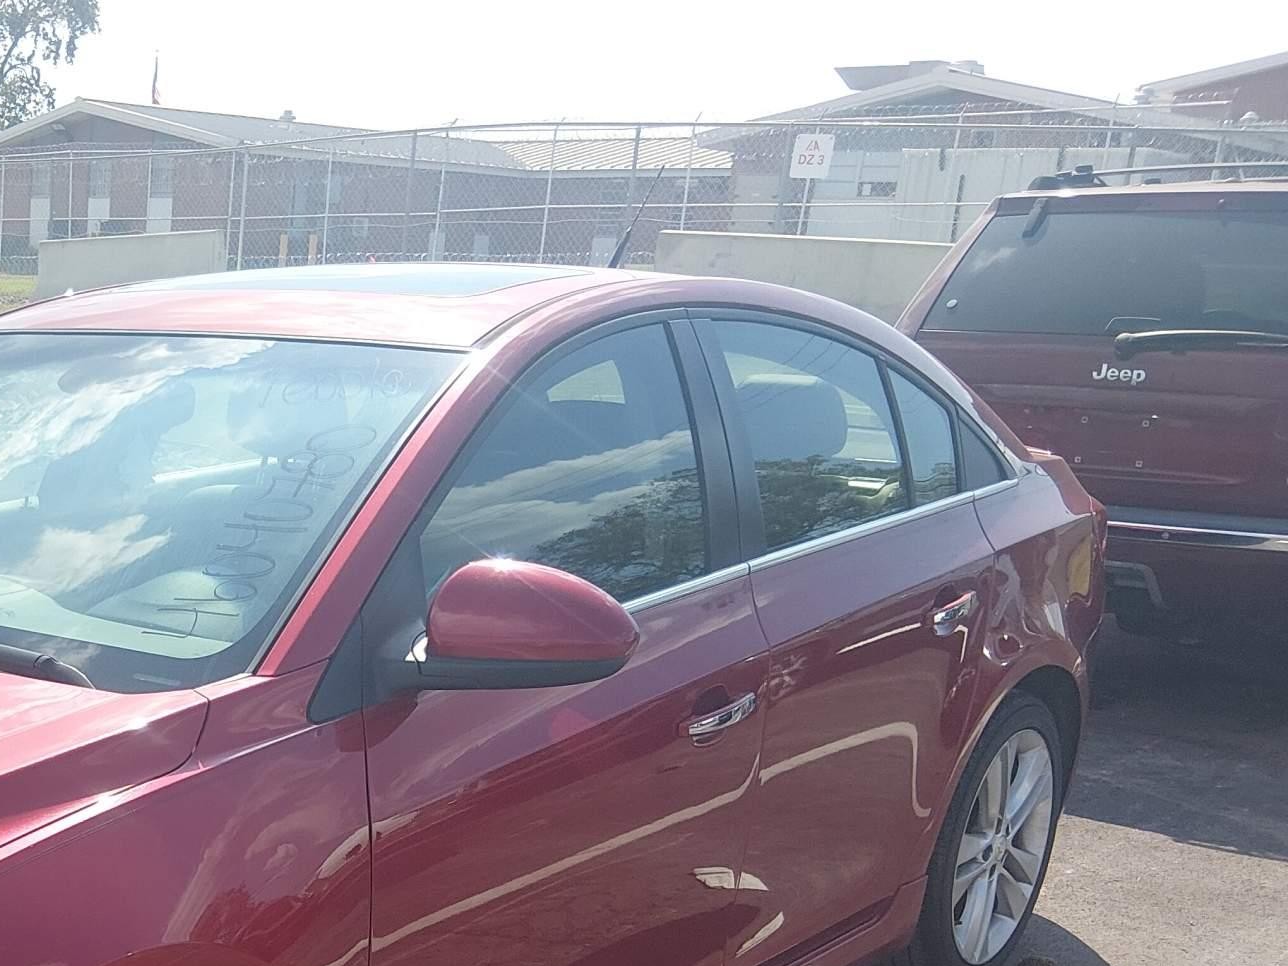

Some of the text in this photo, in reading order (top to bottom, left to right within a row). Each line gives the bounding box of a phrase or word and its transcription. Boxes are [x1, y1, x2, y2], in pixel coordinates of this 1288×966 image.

[798, 154, 825, 166] DZ 3
[1092, 363, 1146, 386] Jeep
